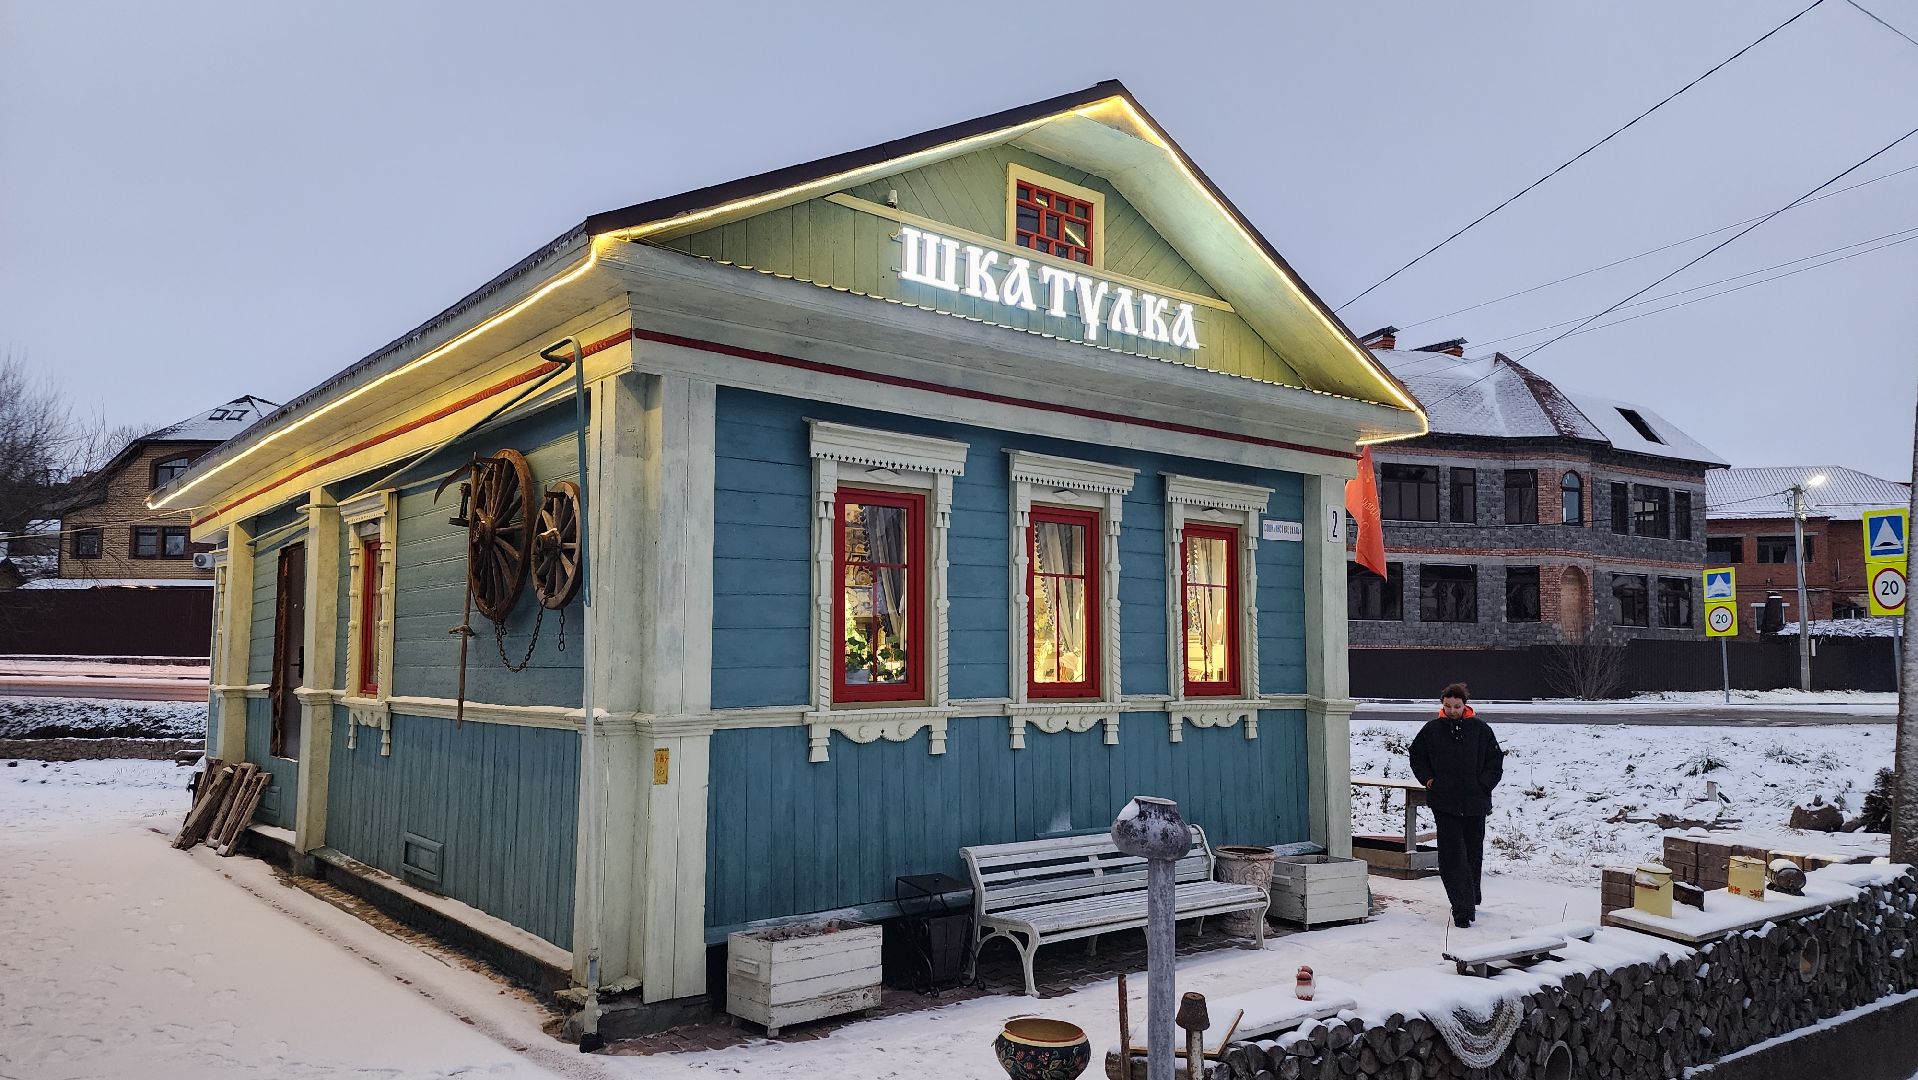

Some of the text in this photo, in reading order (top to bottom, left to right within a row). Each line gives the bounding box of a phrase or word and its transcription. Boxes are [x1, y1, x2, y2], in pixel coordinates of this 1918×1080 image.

[899, 227, 1201, 350] ШКАТУЛКА
[1333, 510, 1338, 538] 2
[1881, 580, 1899, 596] 20
[1715, 613, 1728, 624] 20
